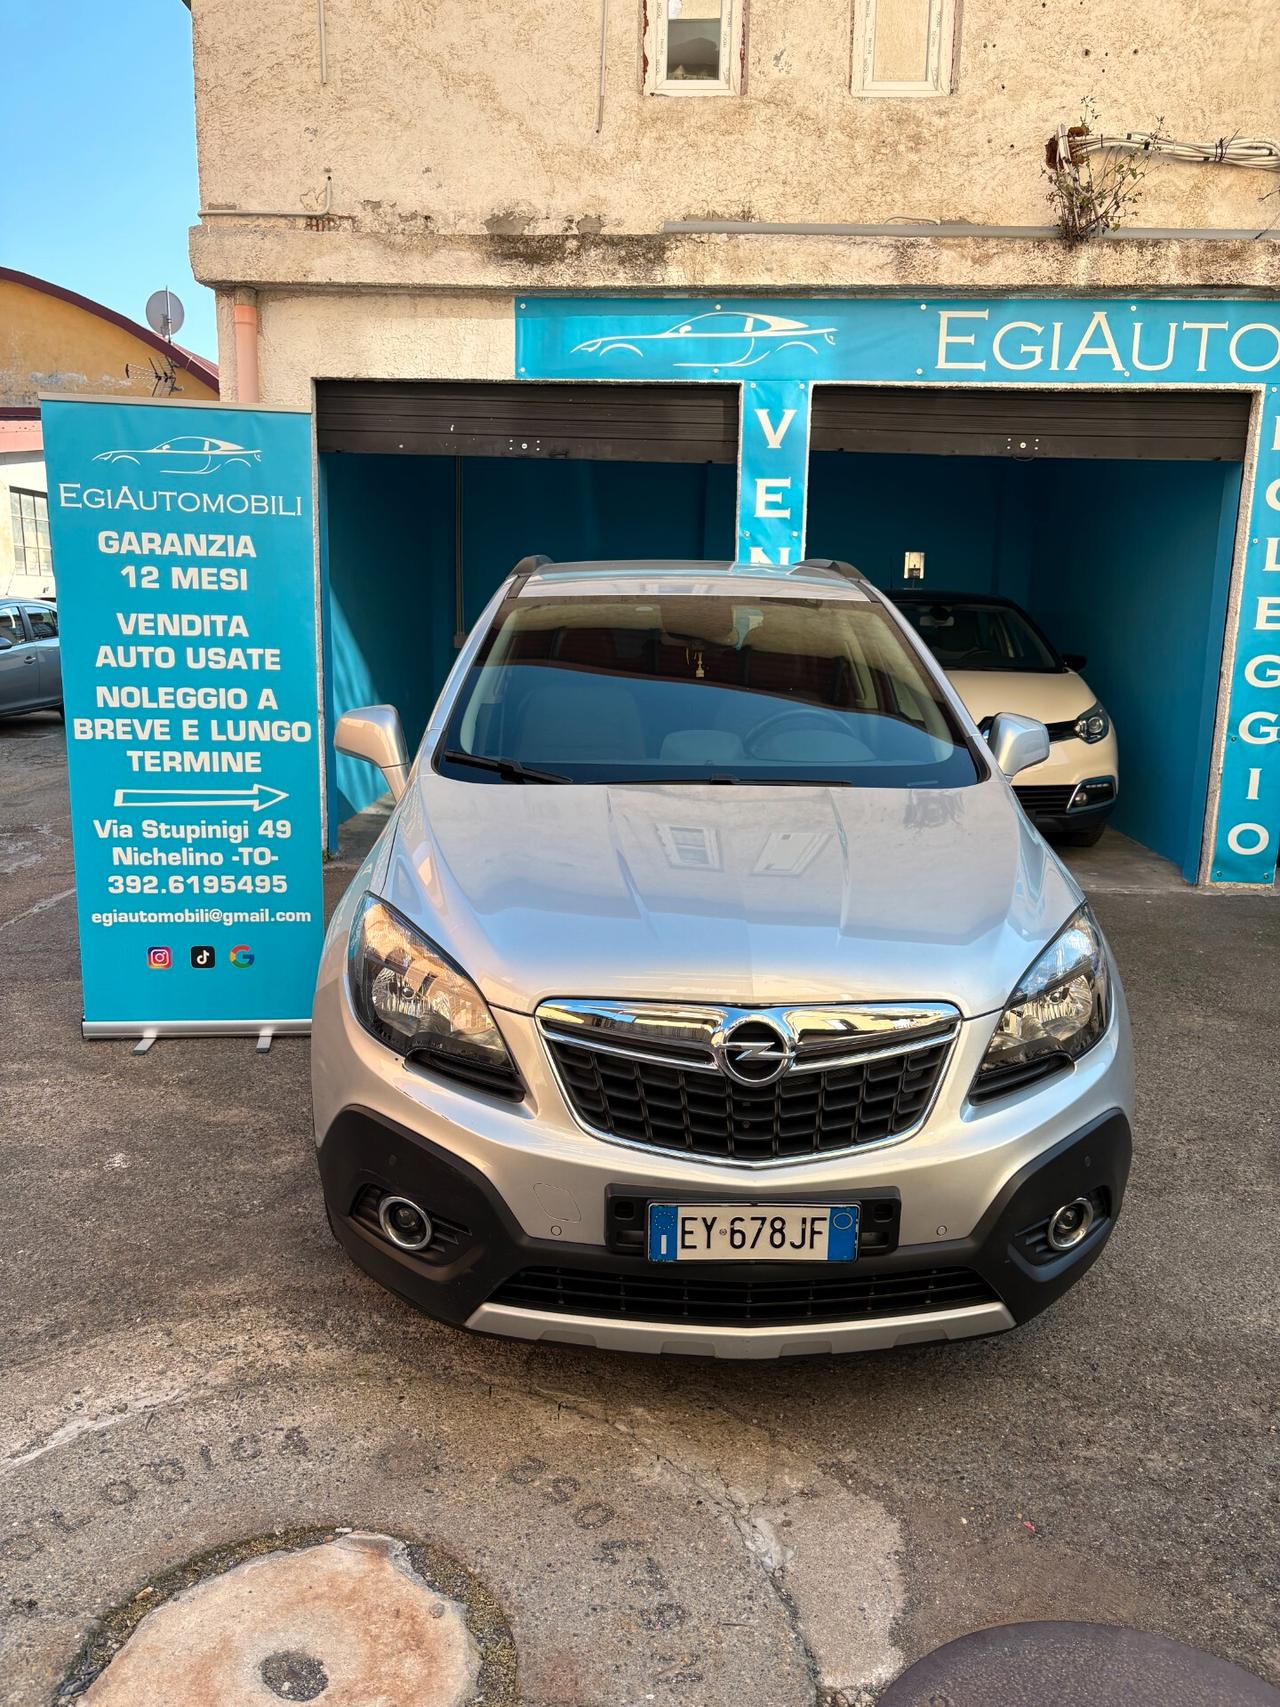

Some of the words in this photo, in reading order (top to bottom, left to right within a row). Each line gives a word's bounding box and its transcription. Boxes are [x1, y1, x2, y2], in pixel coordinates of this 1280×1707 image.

[98, 531, 256, 557] GARANZIA
[121, 566, 159, 588] 12
[172, 567, 247, 590] MESI
[117, 613, 248, 637] VENDITA
[96, 646, 175, 668] AUTO
[187, 648, 280, 670] USATE
[97, 687, 247, 709] NOLEGGIO
[258, 689, 278, 709] A
[74, 719, 170, 740] BREVE
[183, 720, 199, 740] E
[211, 720, 311, 742] LUNGO
[127, 751, 261, 772] TERMINE
[94, 820, 132, 838] Via
[142, 820, 248, 843] Stupinigi
[259, 820, 291, 838] 49
[113, 847, 223, 865] Nichelino
[232, 847, 278, 865] -TO-
[109, 875, 287, 893] 392.6195495
[92, 909, 310, 926] egiautomobili@gmail.com
[681, 1216, 718, 1249] EY
[729, 1216, 828, 1249] 678JF
